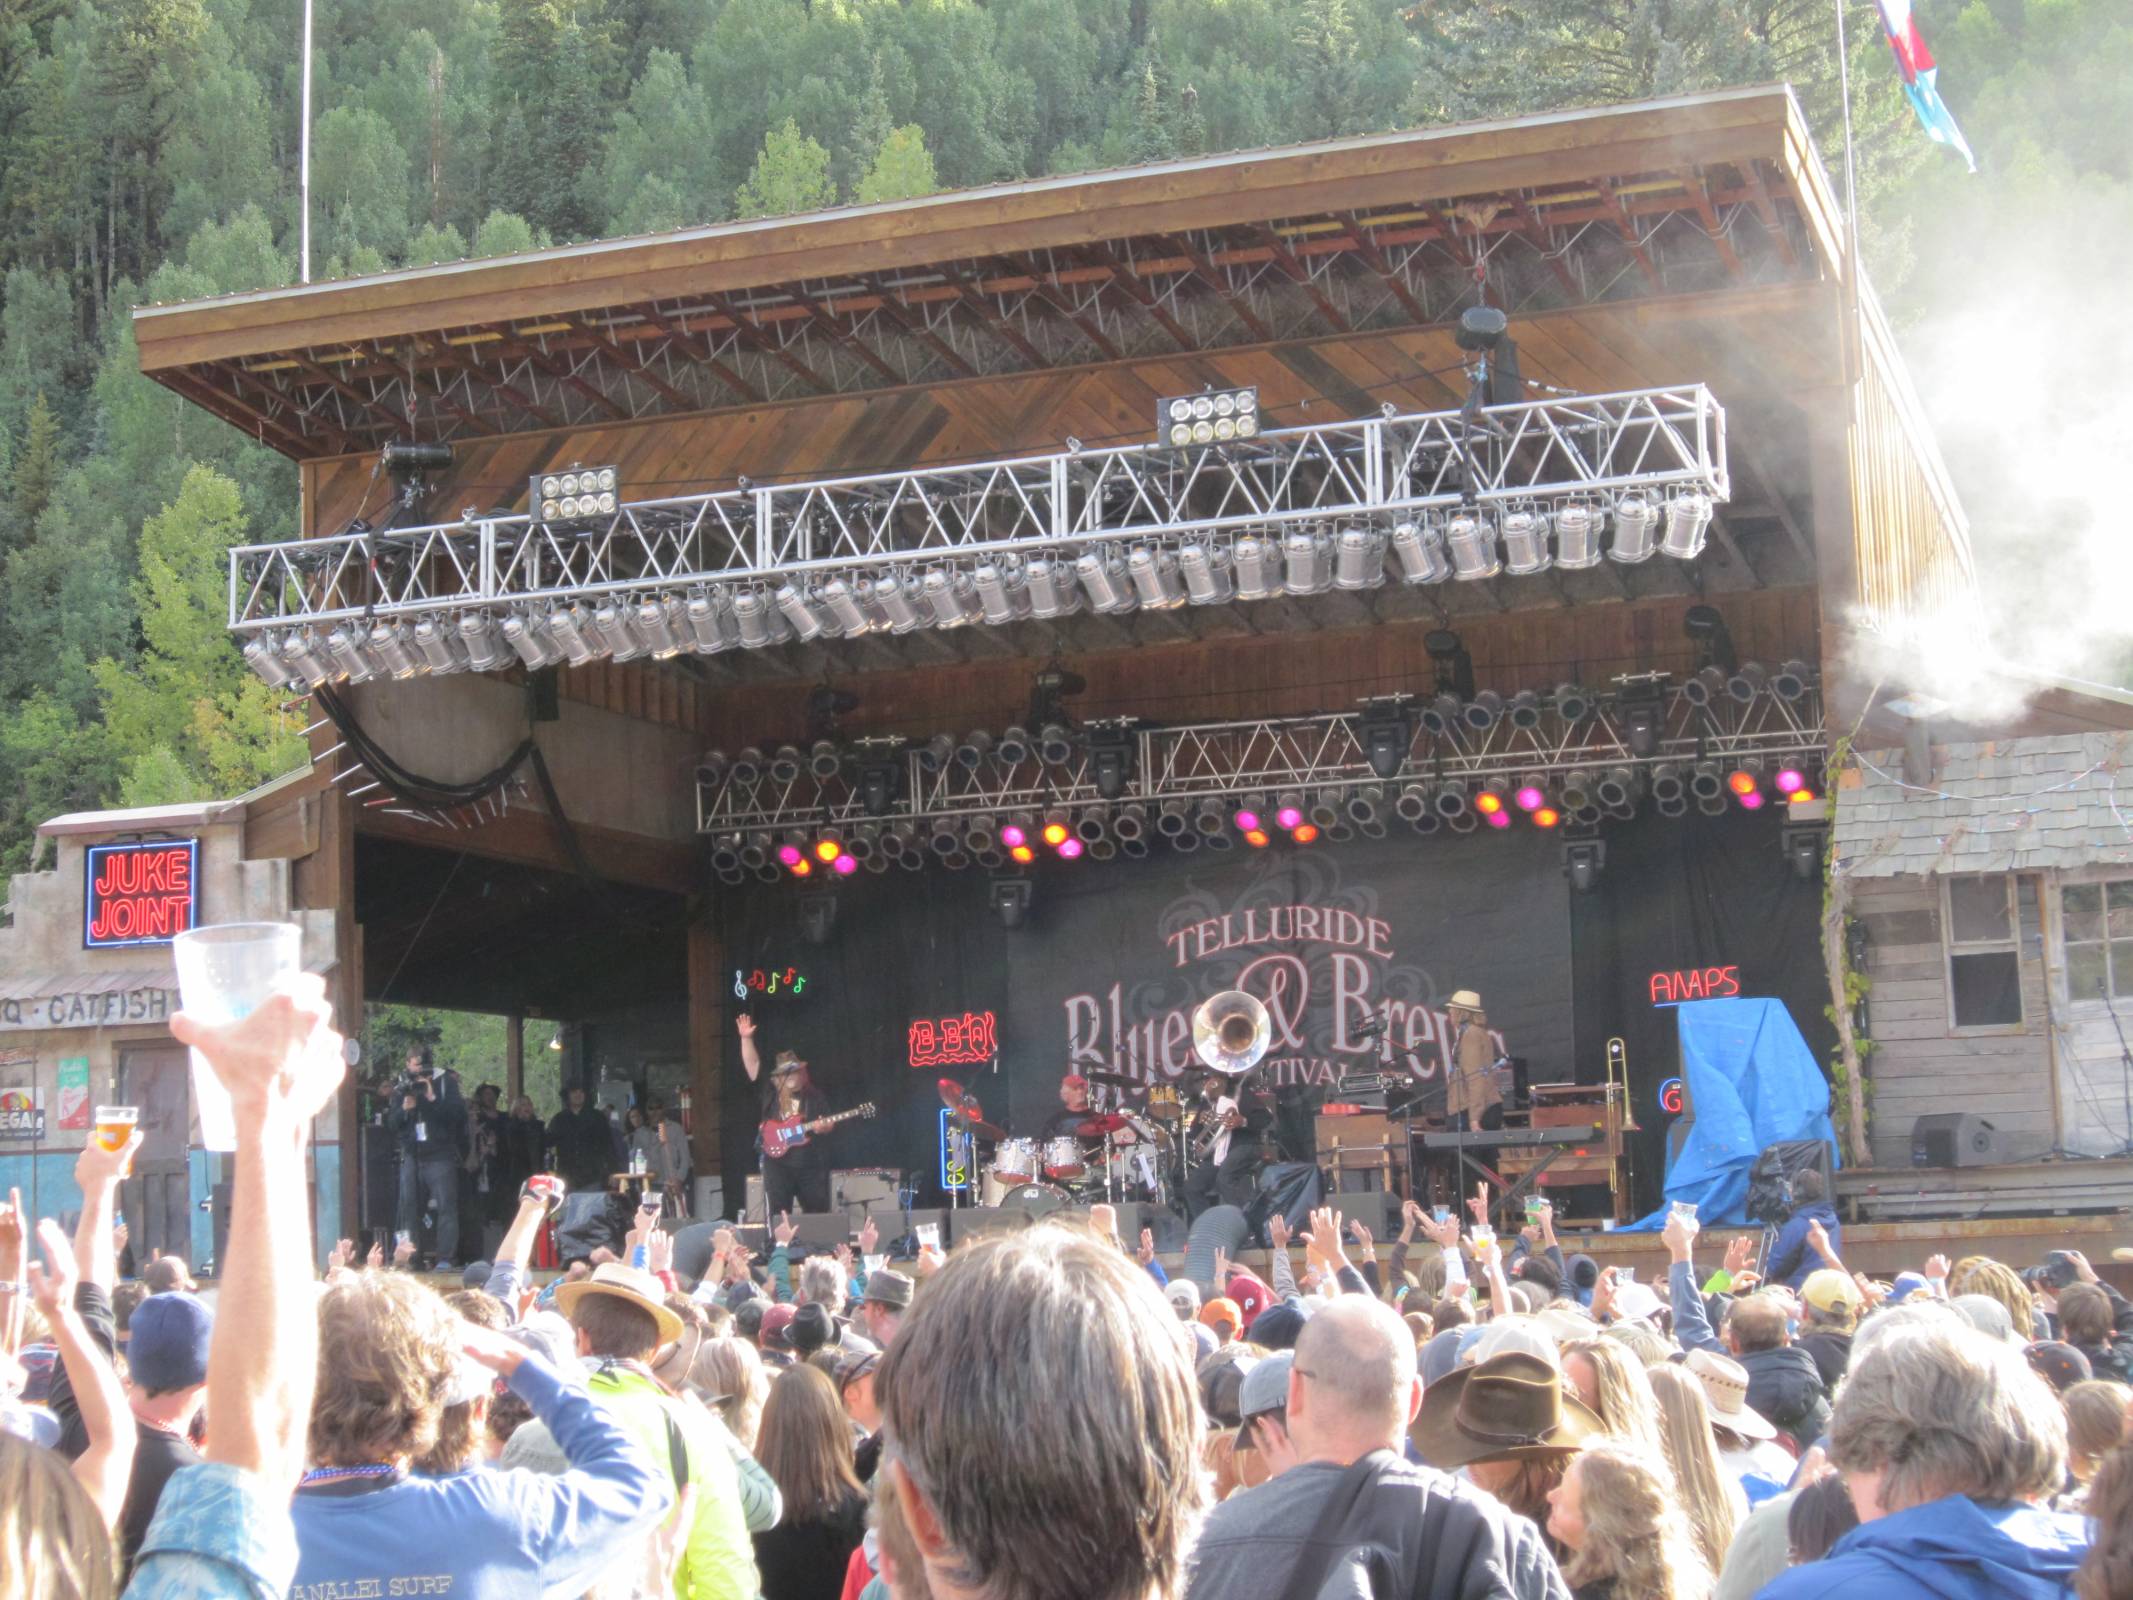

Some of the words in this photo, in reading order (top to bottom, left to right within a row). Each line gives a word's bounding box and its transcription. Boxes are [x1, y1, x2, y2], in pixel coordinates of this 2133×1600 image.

[96, 850, 190, 895] JUKE
[91, 897, 191, 938] JOINT
[1167, 905, 1394, 967] TELLURIDE
[1651, 966, 1740, 1001] AMPS
[50, 990, 167, 1024] CATFISH
[1064, 981, 1203, 1113] Blue
[1332, 953, 1507, 1084] Bre
[293, 1579, 383, 1600] ANALEI
[389, 1575, 452, 1596] SURF
